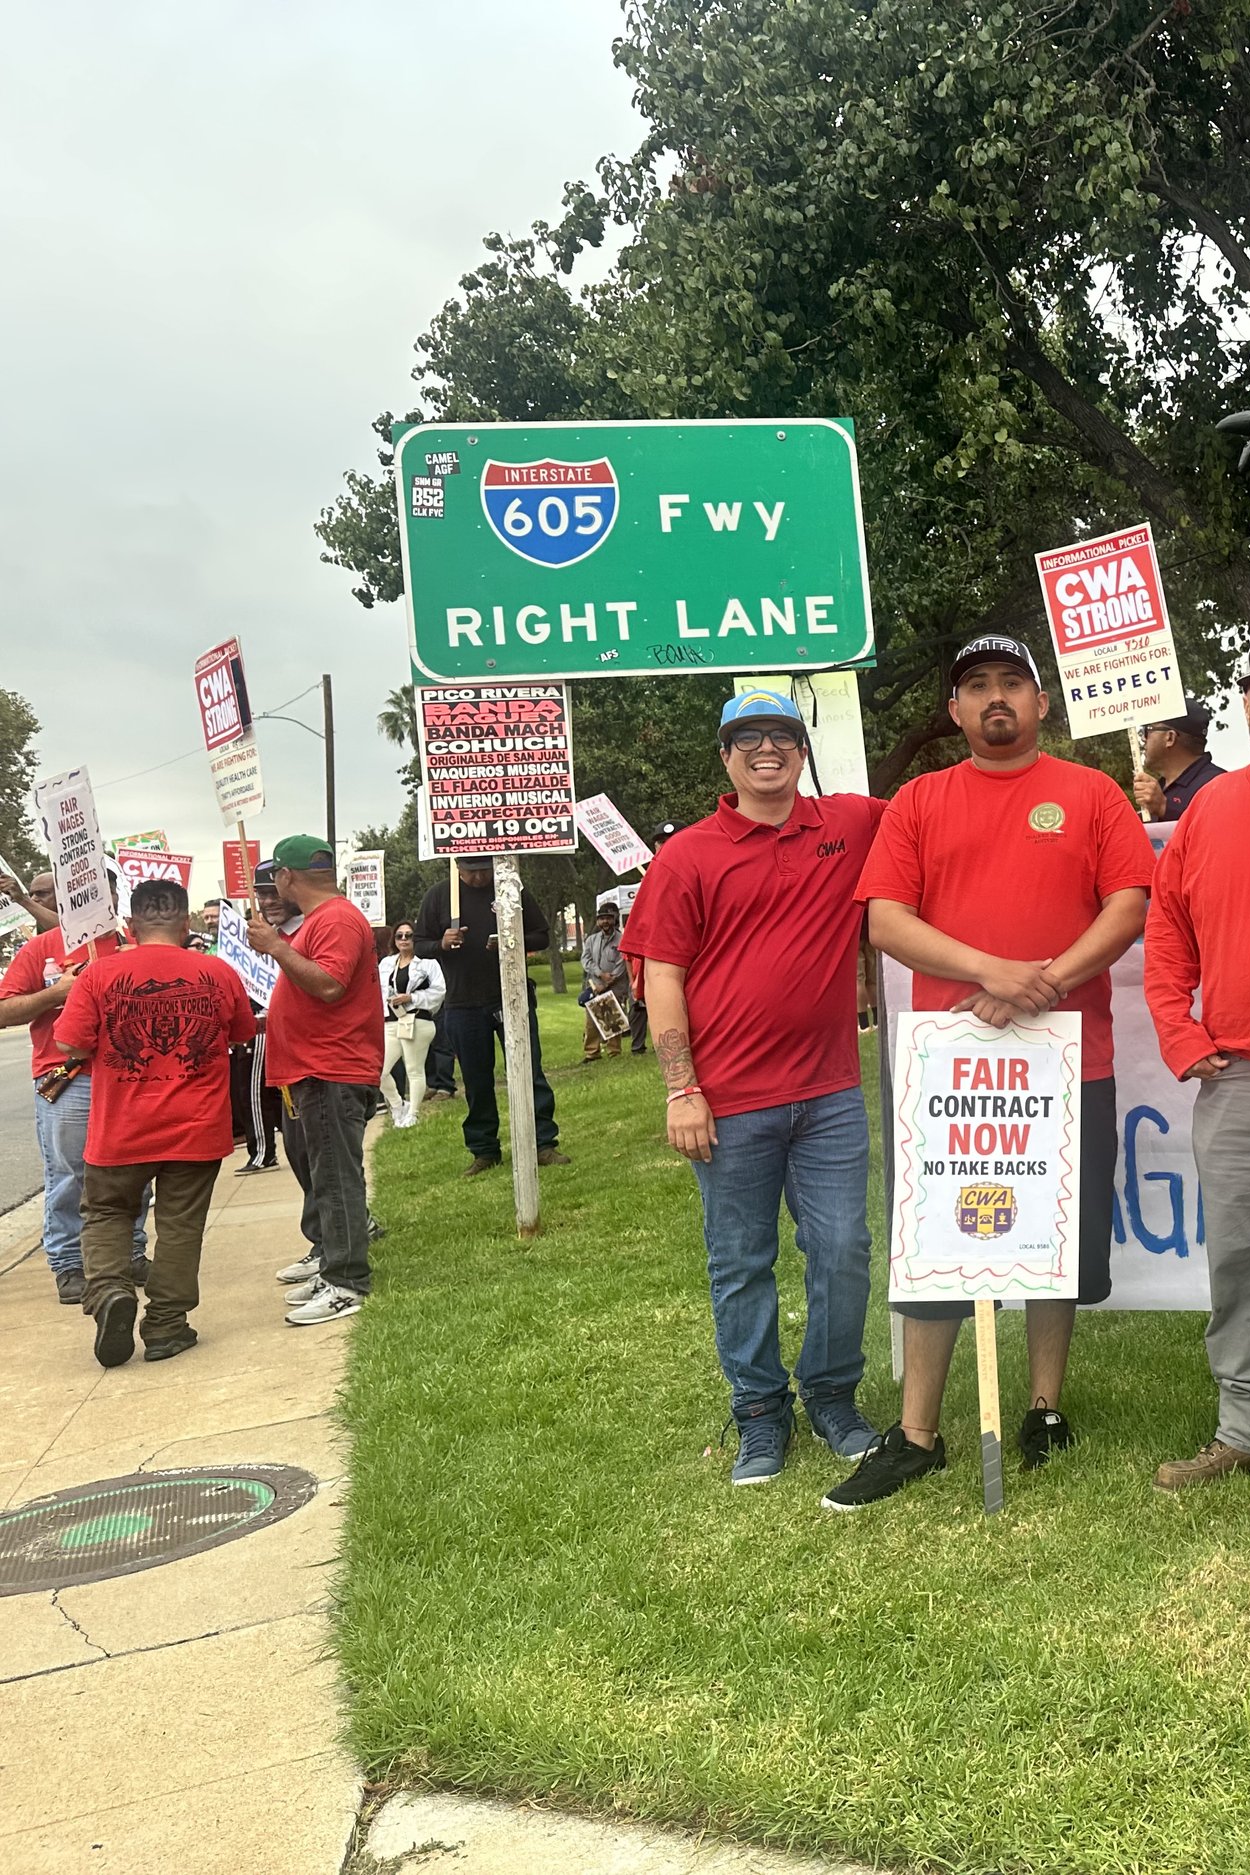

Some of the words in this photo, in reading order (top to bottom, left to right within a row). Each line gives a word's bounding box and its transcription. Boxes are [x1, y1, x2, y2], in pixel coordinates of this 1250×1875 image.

[425, 452, 459, 465] CAMEL
[434, 464, 453, 476] AGF
[505, 468, 593, 483] INTERSTATE
[412, 487, 444, 507] B52
[412, 507, 427, 517] CLK
[428, 508, 444, 518] FYC
[503, 495, 604, 537] 605
[658, 493, 786, 541] Fwy
[1043, 542, 1117, 570] INFORMATIONAL
[1118, 531, 1146, 549] PICKET
[1055, 556, 1146, 607] CWA
[445, 601, 638, 647] RIGHT
[676, 596, 839, 639] LANE
[1061, 588, 1153, 640] STRONG
[600, 648, 619, 662] AFS
[1064, 667, 1081, 680] WE
[1083, 662, 1102, 676] ARE
[1103, 651, 1147, 672] FIGHTING
[1149, 646, 1171, 661] FOR:
[200, 664, 233, 709] CWA
[1071, 666, 1171, 702] RESPECT
[423, 689, 476, 701] PICO
[481, 687, 561, 699] RIVERA
[424, 700, 563, 716] BANDA
[1089, 704, 1106, 719] IT'S
[1108, 701, 1129, 715] OUR
[1132, 693, 1161, 711] TURN!
[204, 694, 239, 738] STRONG
[425, 712, 563, 726] MAGUEY
[427, 726, 499, 740] BANDA
[504, 723, 563, 737] MACH
[427, 736, 566, 754] COHUICH
[223, 751, 247, 767] FIGHTING
[430, 754, 494, 766] ORIGINALES
[497, 753, 511, 763] DE
[513, 752, 535, 762] SAN
[538, 750, 566, 761] JUAN
[229, 770, 246, 784] HEALTH
[246, 765, 258, 778] CARE
[429, 765, 504, 780] VAQUEROS
[507, 762, 567, 776] MUSICAL
[231, 782, 255, 797] AFFORDABLE
[431, 781, 449, 793] EL
[452, 779, 498, 792] FLACO
[502, 776, 569, 790] ELIZALDE
[60, 797, 78, 817] FAIR
[432, 794, 504, 809] INVIERNO
[506, 790, 569, 805] MUSICAL
[433, 809, 456, 821] LA
[459, 804, 571, 820] EXPECTATIVA
[585, 807, 601, 816] FAIR
[586, 812, 610, 824] WAGES
[58, 811, 85, 835] WAGES
[434, 822, 487, 839] DOM
[493, 819, 520, 836] 19
[525, 816, 572, 834] OCT
[592, 818, 615, 831] STRONG
[593, 823, 624, 838] CONTRACTS
[61, 828, 88, 850] STRONG
[451, 837, 487, 845] TICKETS
[488, 835, 544, 844] DISPONIBLES
[604, 834, 630, 848] BENEFITS
[605, 831, 622, 840] GOOD
[59, 840, 96, 866] CONTRACTS
[119, 850, 169, 860] INFORMATIONAL
[170, 855, 192, 863] PICKET
[436, 844, 506, 853] TICKETON
[509, 842, 518, 850] Y
[610, 844, 630, 855] NOW
[816, 838, 846, 859] CWA
[70, 857, 90, 876] GOOD
[123, 859, 183, 881] CWA
[350, 865, 370, 874] SHAME
[369, 864, 378, 872] ON
[66, 868, 98, 894] BENEFITS
[351, 873, 378, 882] FRONTIER
[69, 890, 91, 912] NOW
[220, 931, 276, 990] FOREVER
[119, 1000, 179, 1020] COMMUNICATIONS
[180, 998, 214, 1018] WORKERS
[117, 1074, 174, 1083] LOCAL
[952, 1057, 1030, 1091] FAIR
[928, 1095, 1054, 1118] CONTRACT
[948, 1123, 1031, 1155] NOW
[923, 1160, 946, 1176] NO
[949, 1160, 989, 1176] TAKE
[994, 1160, 1048, 1176] BACKS
[964, 1190, 1008, 1206] CWA
